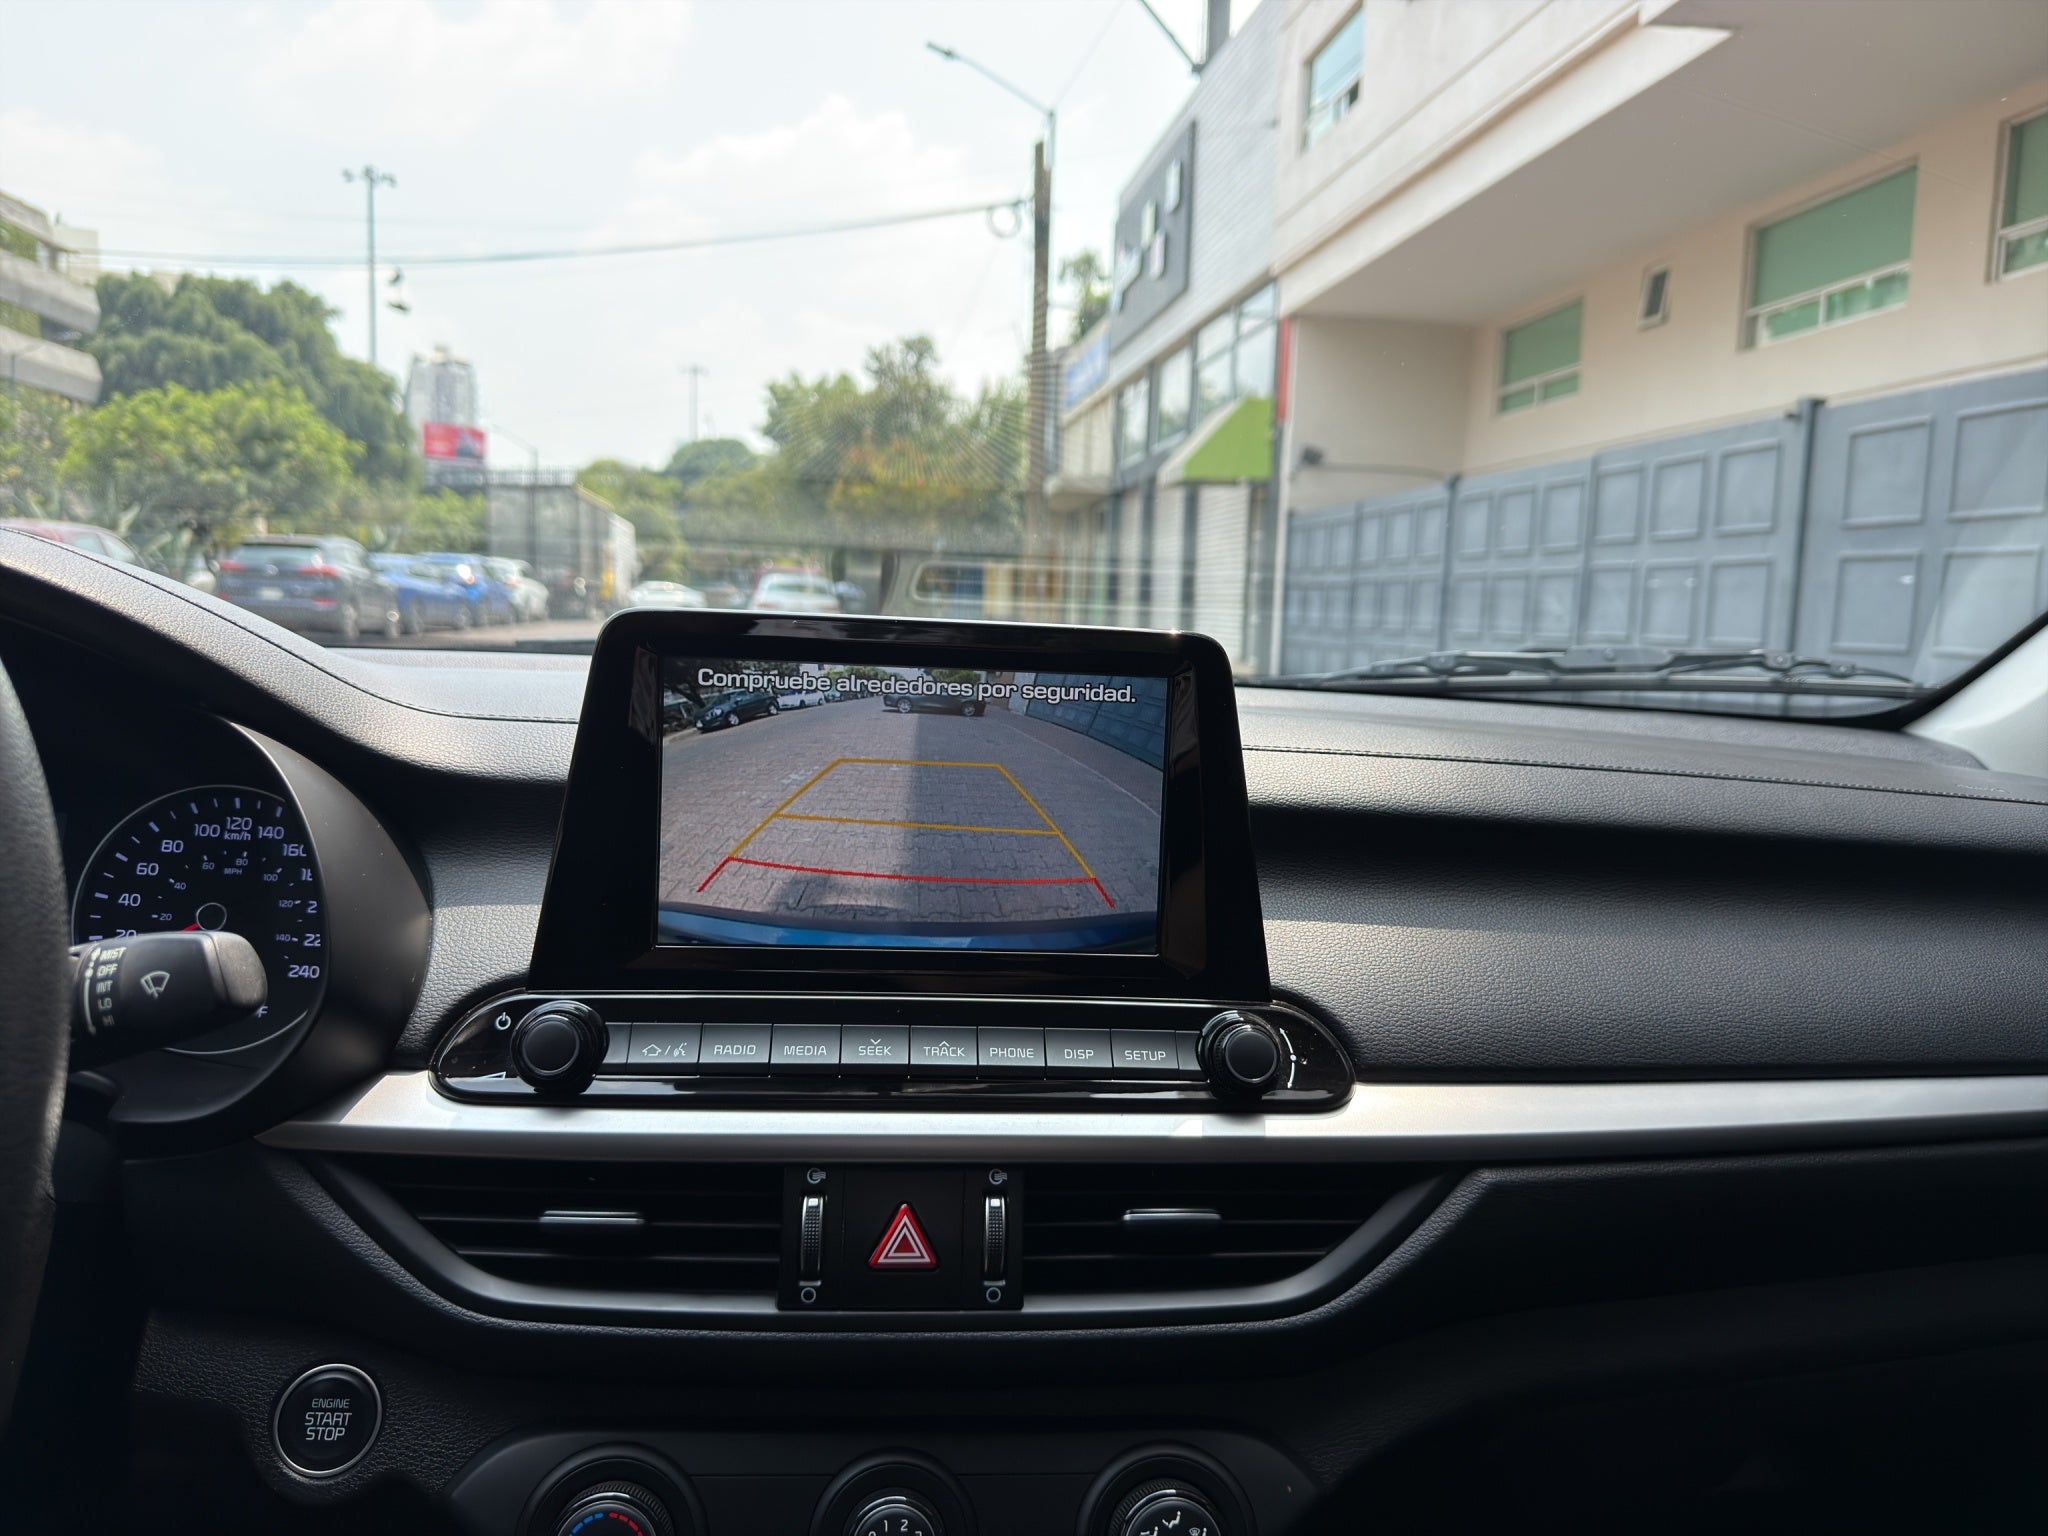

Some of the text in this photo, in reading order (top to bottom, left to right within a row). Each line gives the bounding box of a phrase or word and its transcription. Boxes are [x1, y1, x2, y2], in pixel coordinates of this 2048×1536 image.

[697, 668, 1136, 704] Compruebe alrededores por seguridad.
[226, 816, 252, 831] 120
[194, 824, 221, 838] 100
[224, 831, 251, 840] km/h
[258, 826, 285, 840] 140
[161, 839, 184, 853] 80
[136, 862, 159, 876] 60
[202, 862, 215, 870] 60
[223, 867, 242, 875] MPH
[263, 873, 279, 882] 100
[173, 882, 187, 890] 40
[118, 893, 141, 907] 40
[159, 913, 172, 921] 20
[99, 946, 127, 961] MIST
[96, 963, 118, 978] OFF
[288, 964, 320, 979] 240
[96, 980, 113, 994] INT
[713, 1044, 756, 1056] RADIO
[783, 1045, 827, 1057] MEDIA
[858, 1045, 892, 1057] SEEK
[923, 1046, 965, 1058] TRACK
[989, 1047, 1034, 1059] PHONE
[1064, 1048, 1094, 1060] DISP
[1124, 1050, 1166, 1062] SETUP
[311, 1398, 351, 1409] ENGINE
[304, 1412, 352, 1426] START
[305, 1426, 346, 1441] STOP
[883, 1519, 888, 1533] 1
[900, 1519, 909, 1532] 2
